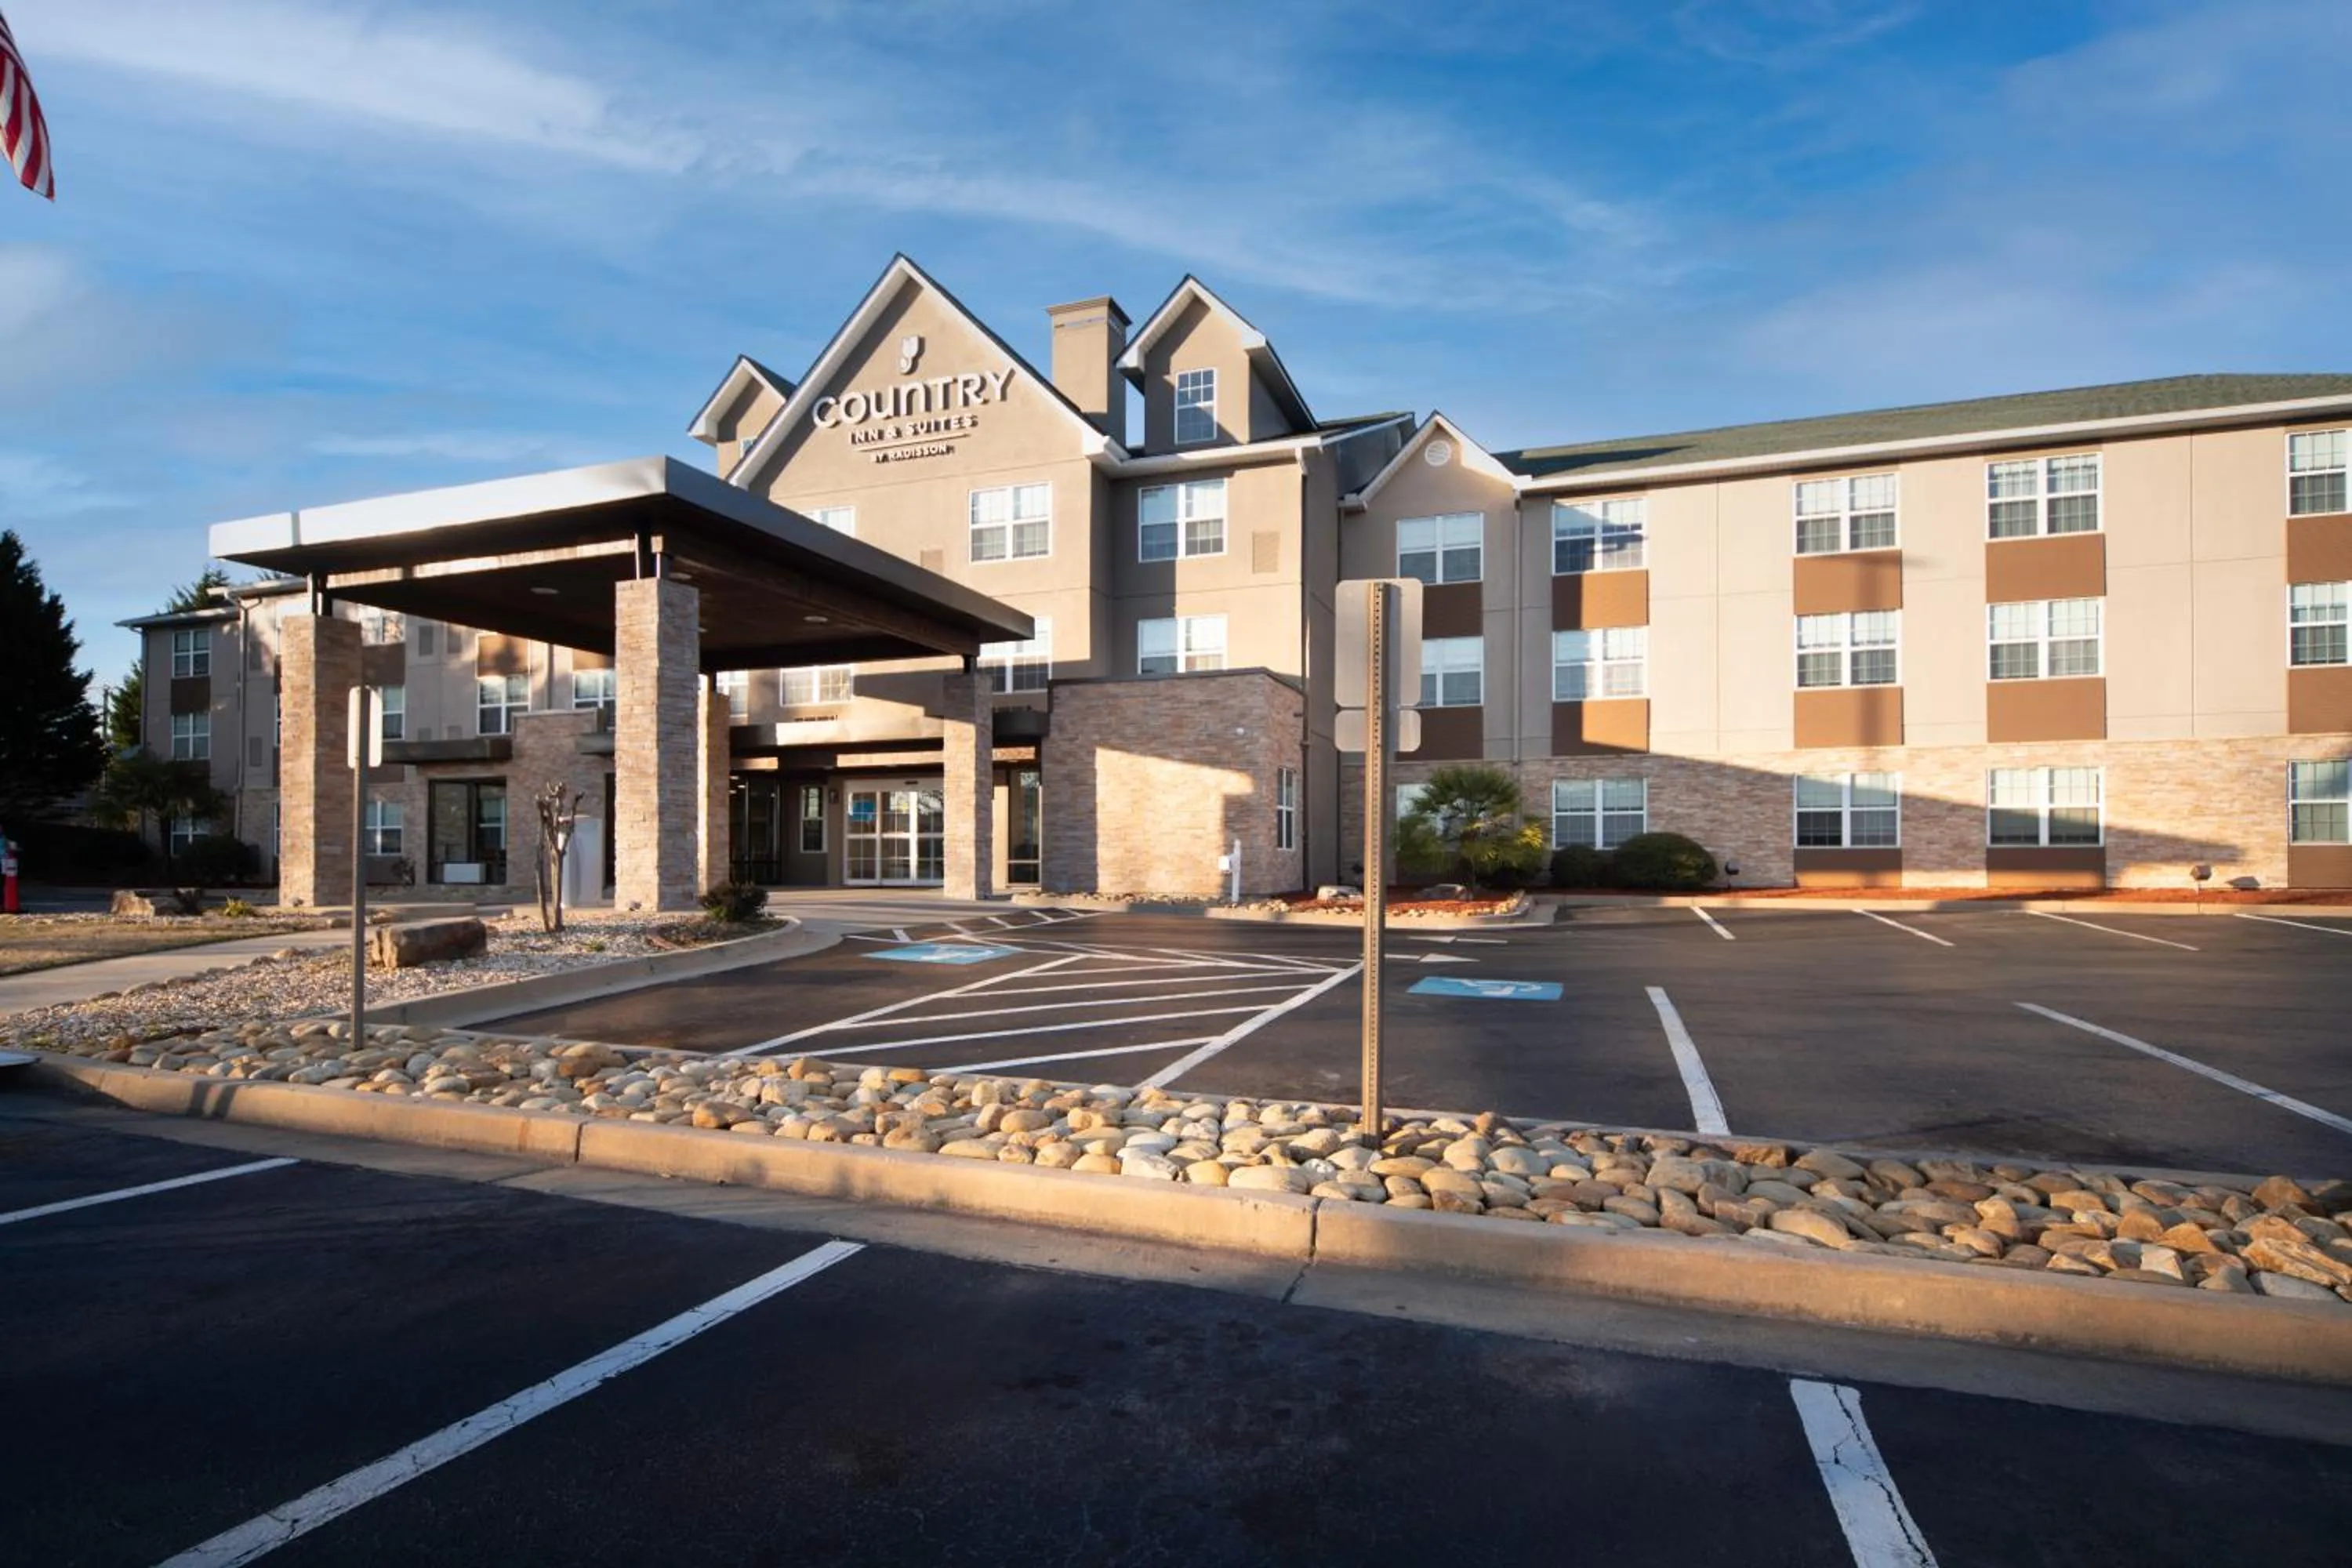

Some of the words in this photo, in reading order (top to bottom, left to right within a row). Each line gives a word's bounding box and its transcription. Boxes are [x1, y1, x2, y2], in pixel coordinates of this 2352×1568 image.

[812, 366, 1014, 428] COUNTRY
[848, 428, 879, 445] INN
[886, 423, 900, 438] &
[906, 414, 976, 435] SUITES
[887, 441, 949, 461] RADISSON
